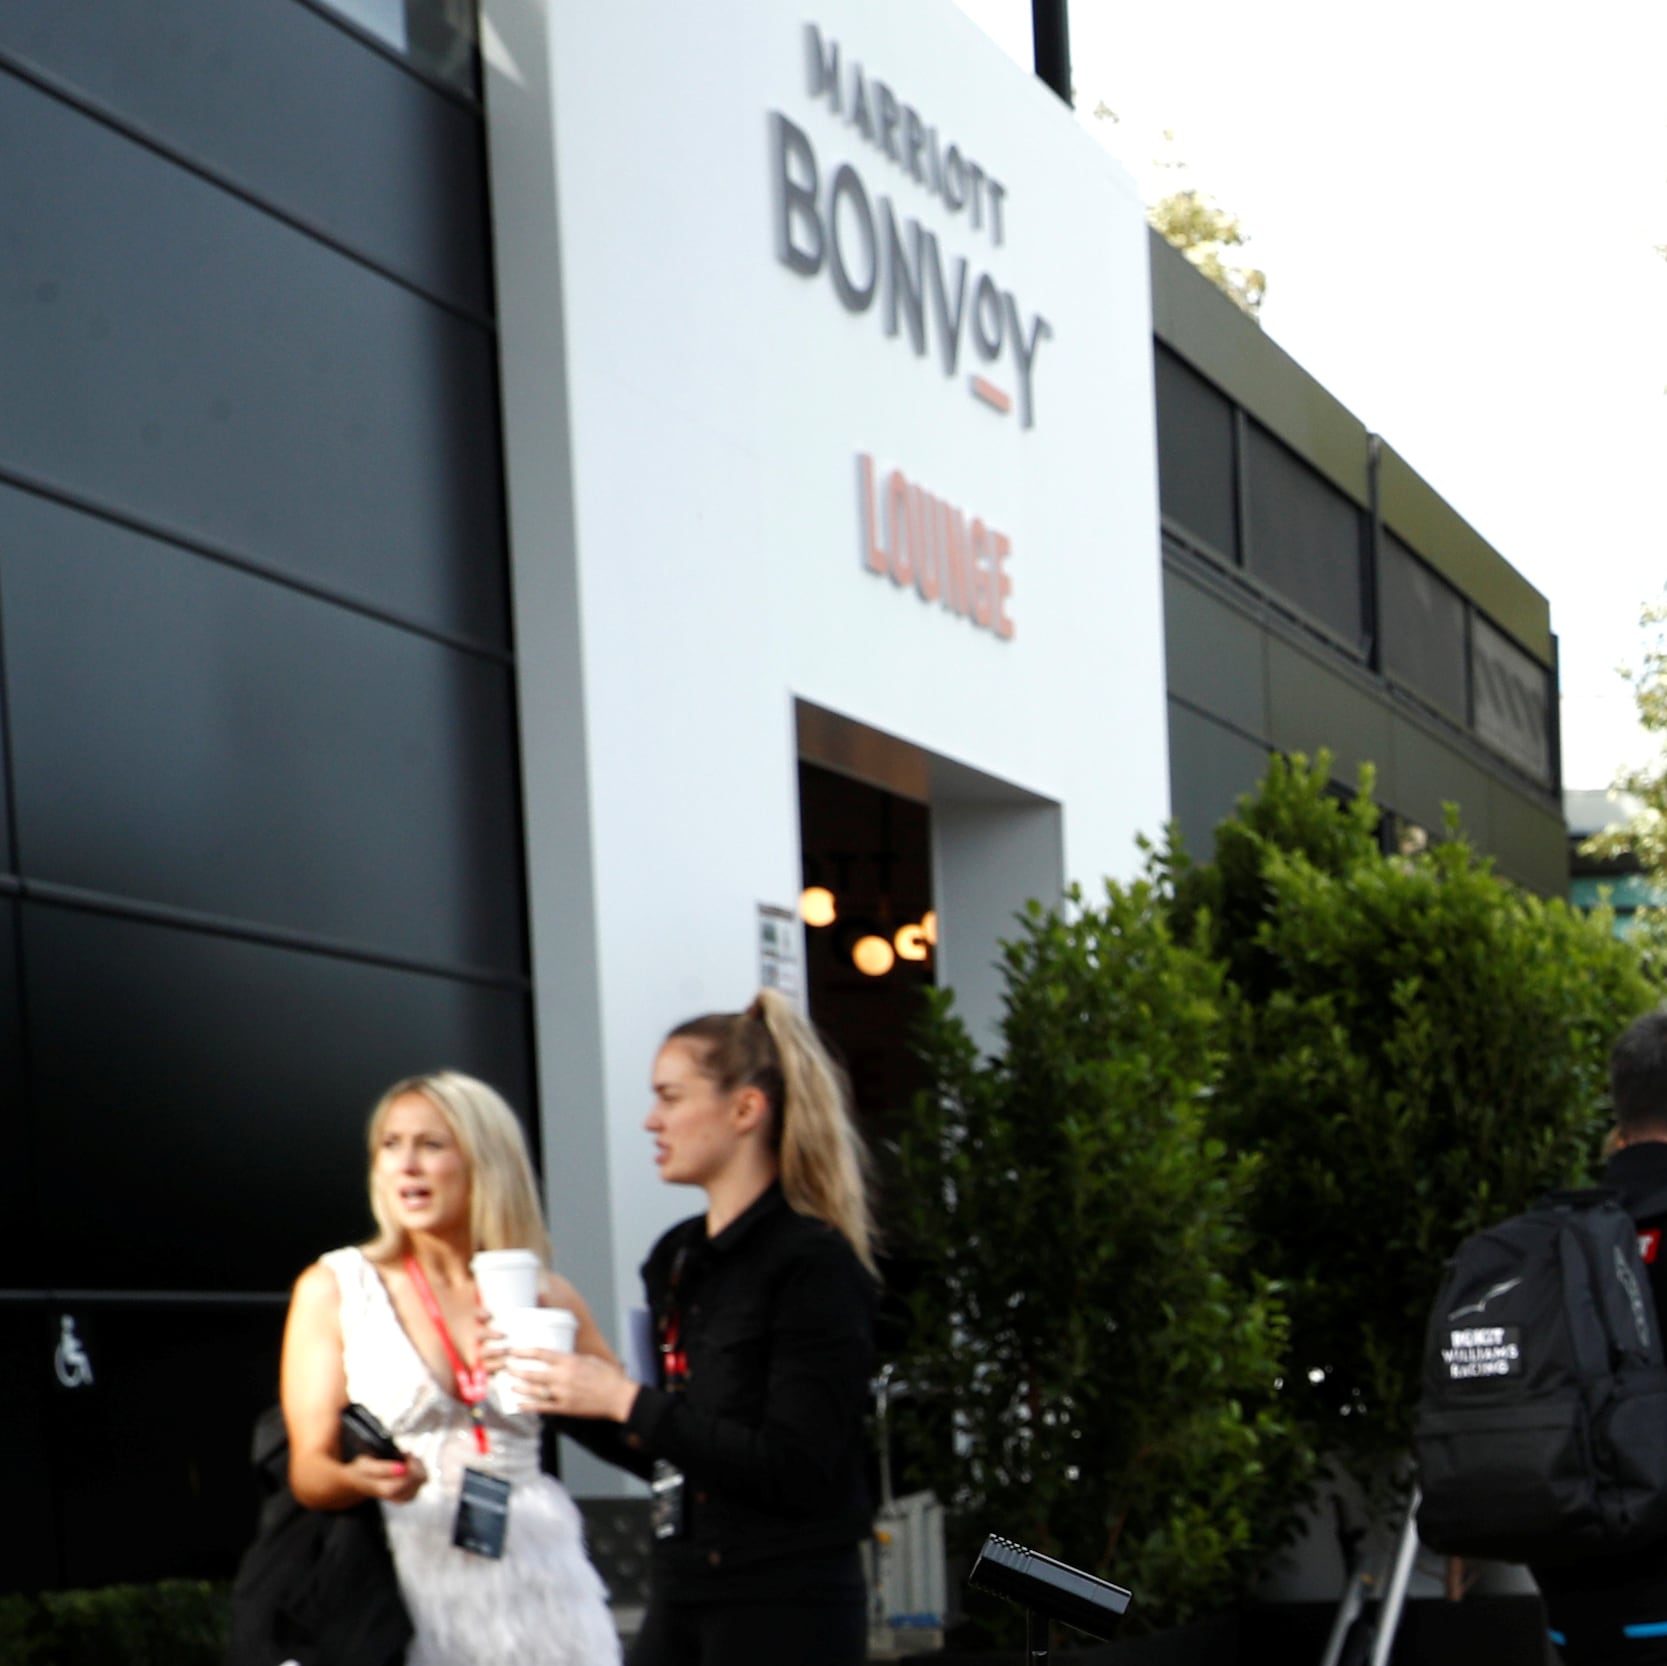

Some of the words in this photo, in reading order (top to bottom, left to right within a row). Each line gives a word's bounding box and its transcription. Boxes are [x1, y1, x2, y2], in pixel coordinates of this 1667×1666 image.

[802, 21, 1006, 247] MARRIOTT
[768, 109, 1052, 431] BONVOY
[855, 452, 1014, 640] LOUNGE
[1441, 1344, 1519, 1364] WILLIAMS
